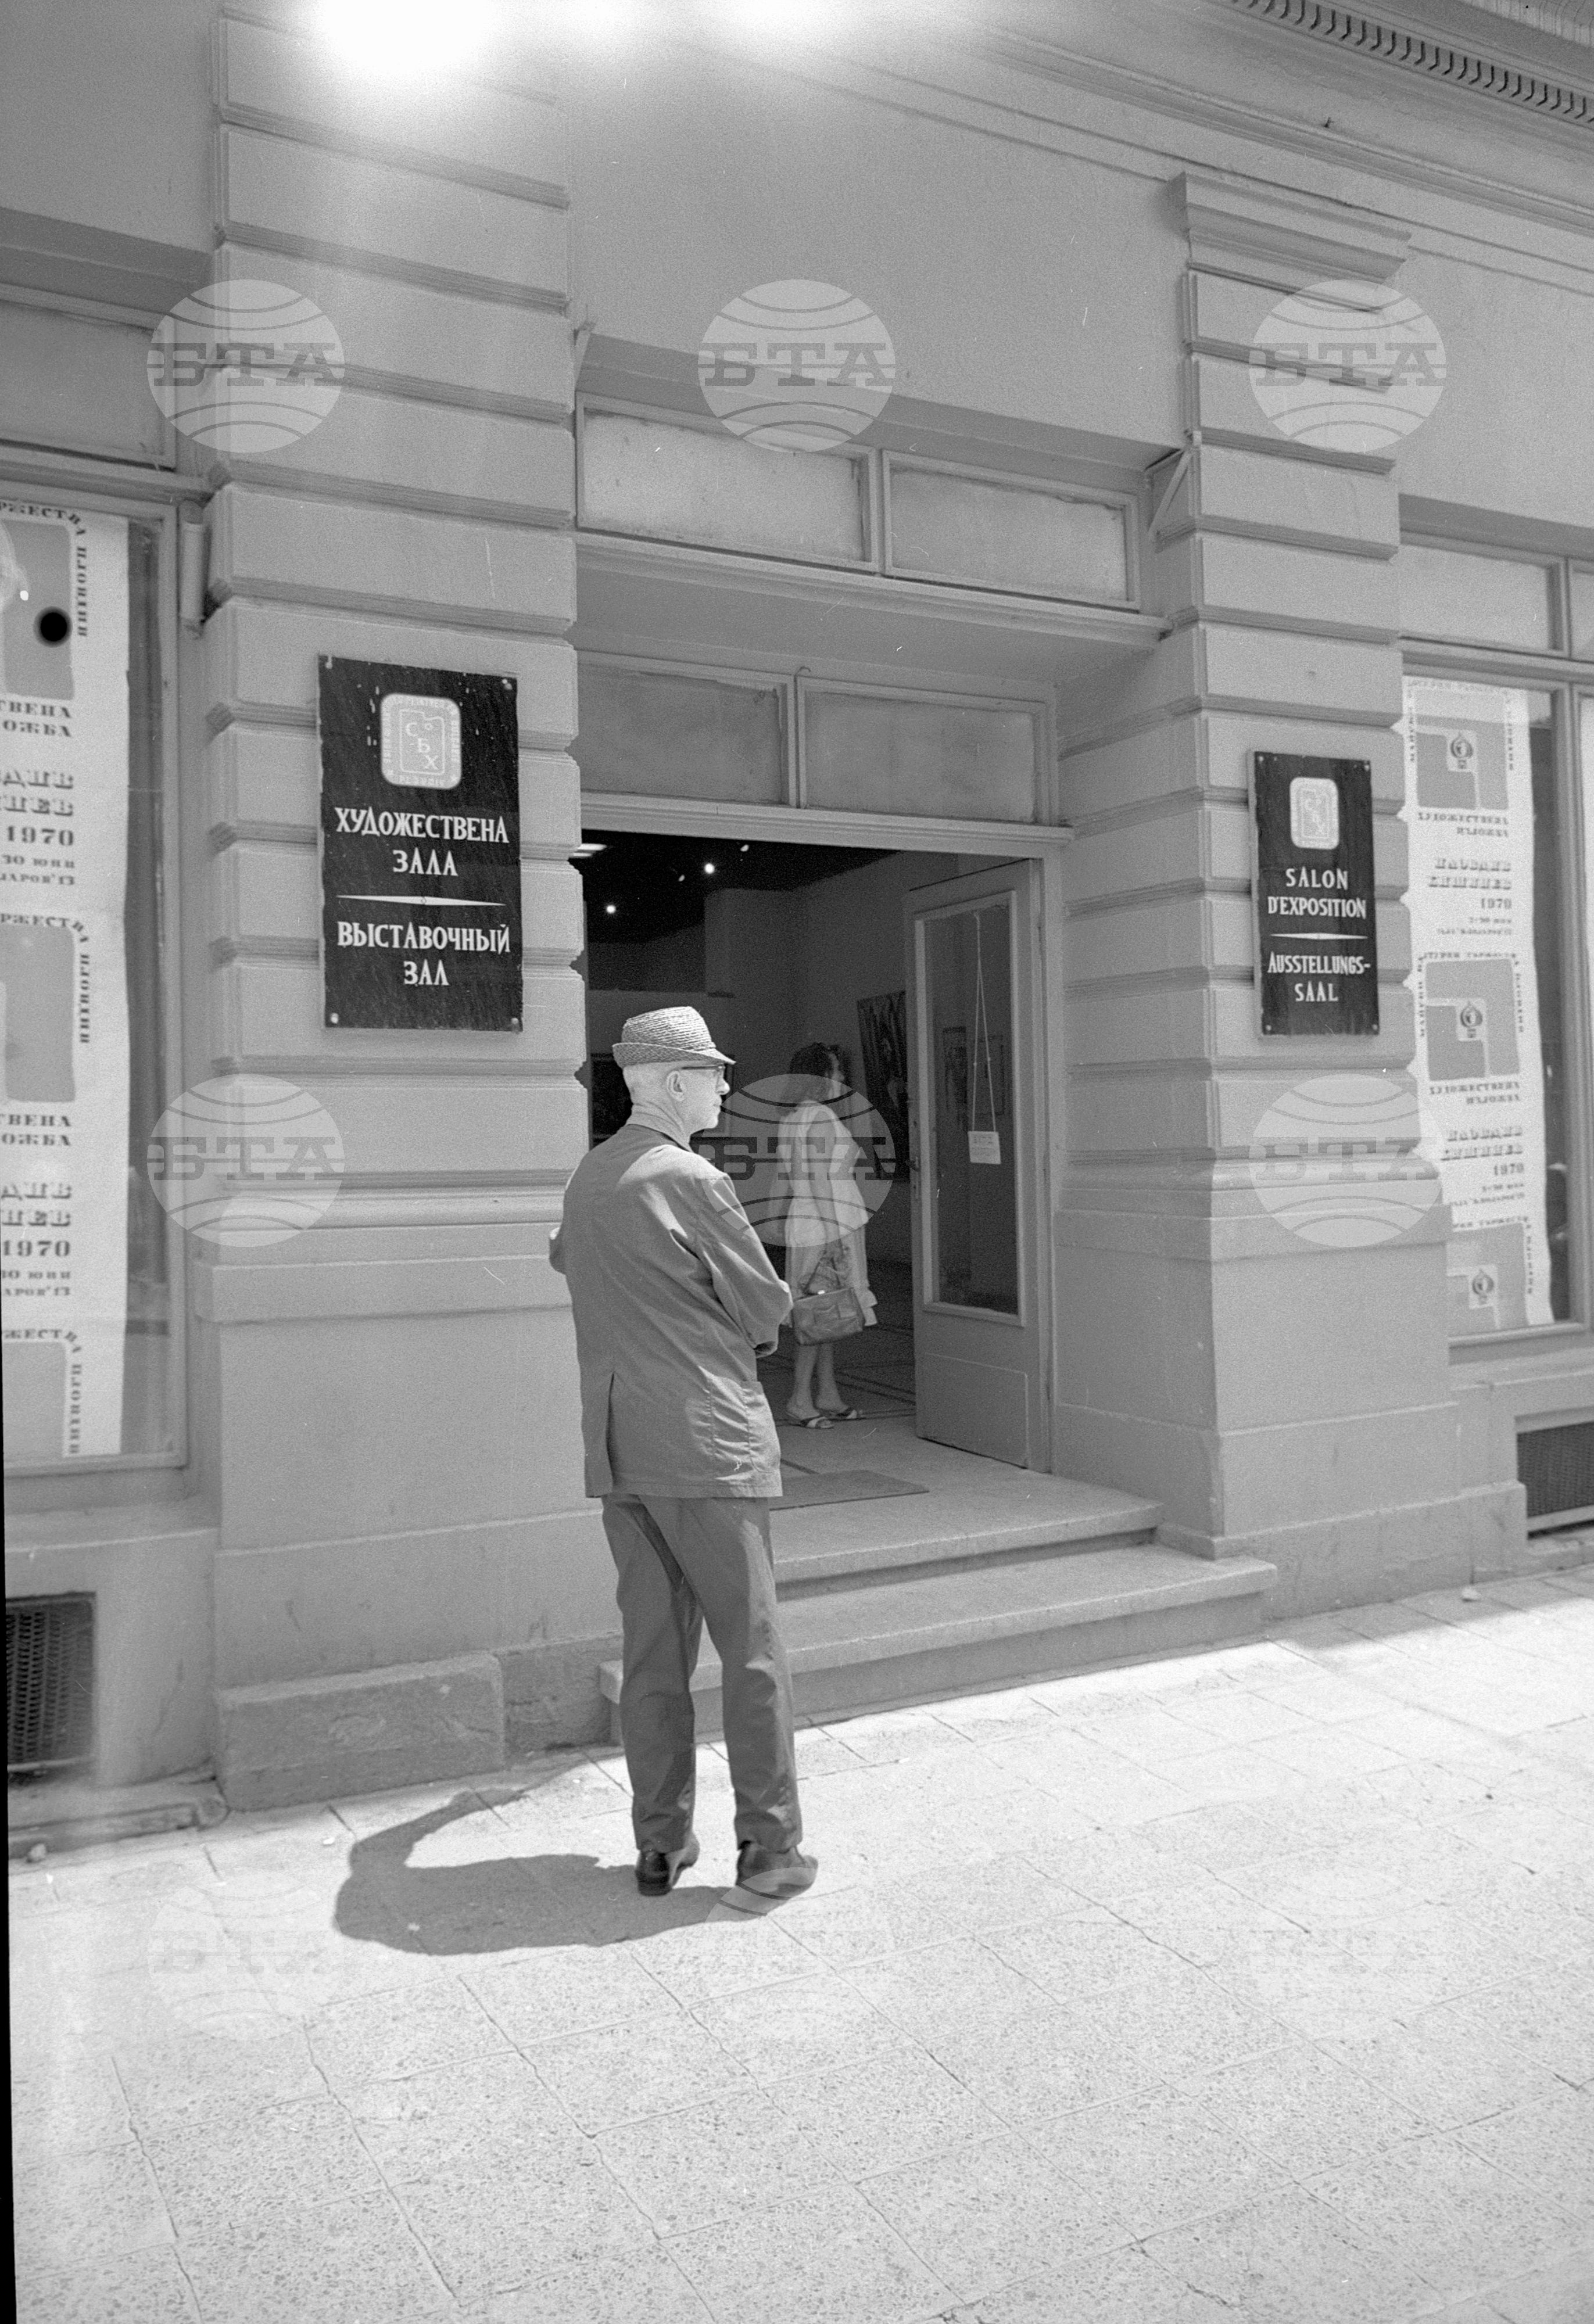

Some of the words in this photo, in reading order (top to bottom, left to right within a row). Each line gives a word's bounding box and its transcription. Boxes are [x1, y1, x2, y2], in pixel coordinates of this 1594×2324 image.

[7, 824, 74, 847] 1970
[334, 806, 510, 844] ХУДОЖЕСТВЕНА
[392, 847, 459, 877] ЗАЛА
[1285, 866, 1348, 891] SALON
[1481, 898, 1512, 910] 1970
[337, 921, 511, 955] ВЫСТАВОЧНЫЙ
[403, 959, 449, 986] ЗАЛ
[1267, 952, 1371, 975] AUSSTELLUNGS-
[1295, 981, 1338, 1002] SAAL
[1493, 1163, 1525, 1176] 1970
[2, 1239, 71, 1257] 1970
